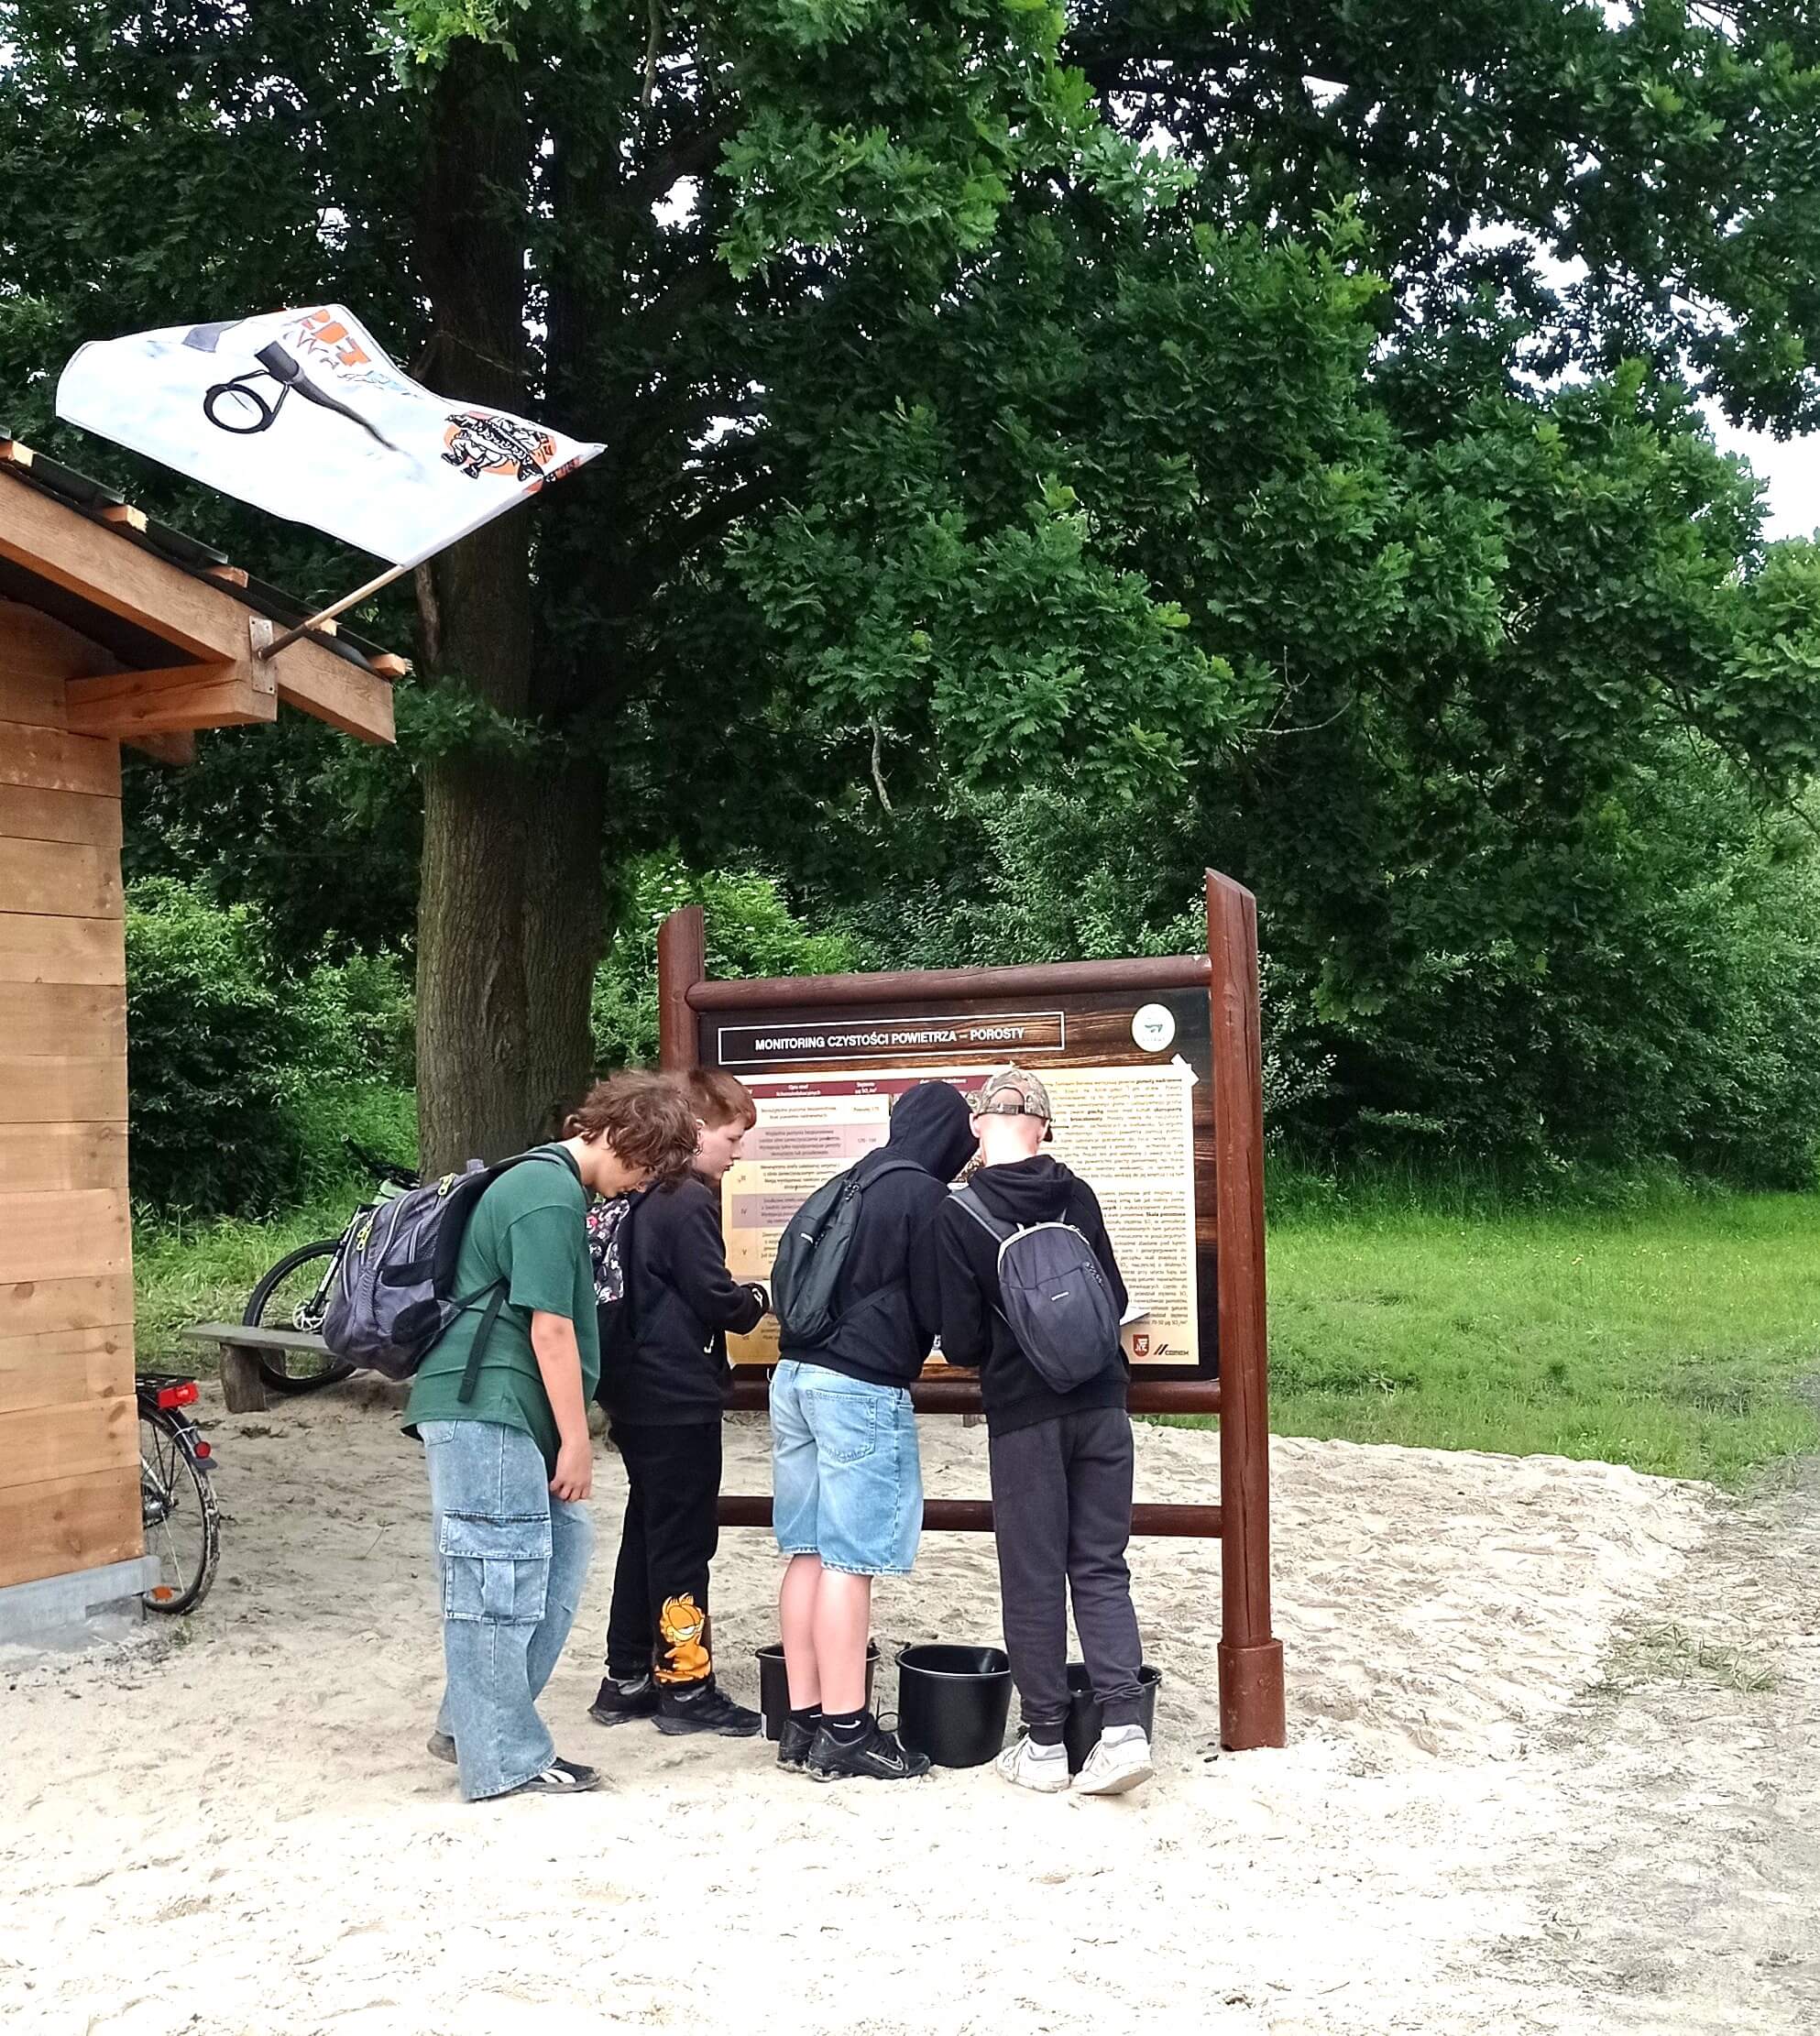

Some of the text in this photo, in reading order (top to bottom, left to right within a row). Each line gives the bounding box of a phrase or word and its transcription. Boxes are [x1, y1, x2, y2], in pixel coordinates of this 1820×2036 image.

[755, 1036, 825, 1051] MONITORING
[828, 1031, 889, 1048] CZYSTOŚCI
[892, 1030, 957, 1045] POWIETRZA
[970, 1027, 1025, 1042] POROSTY
